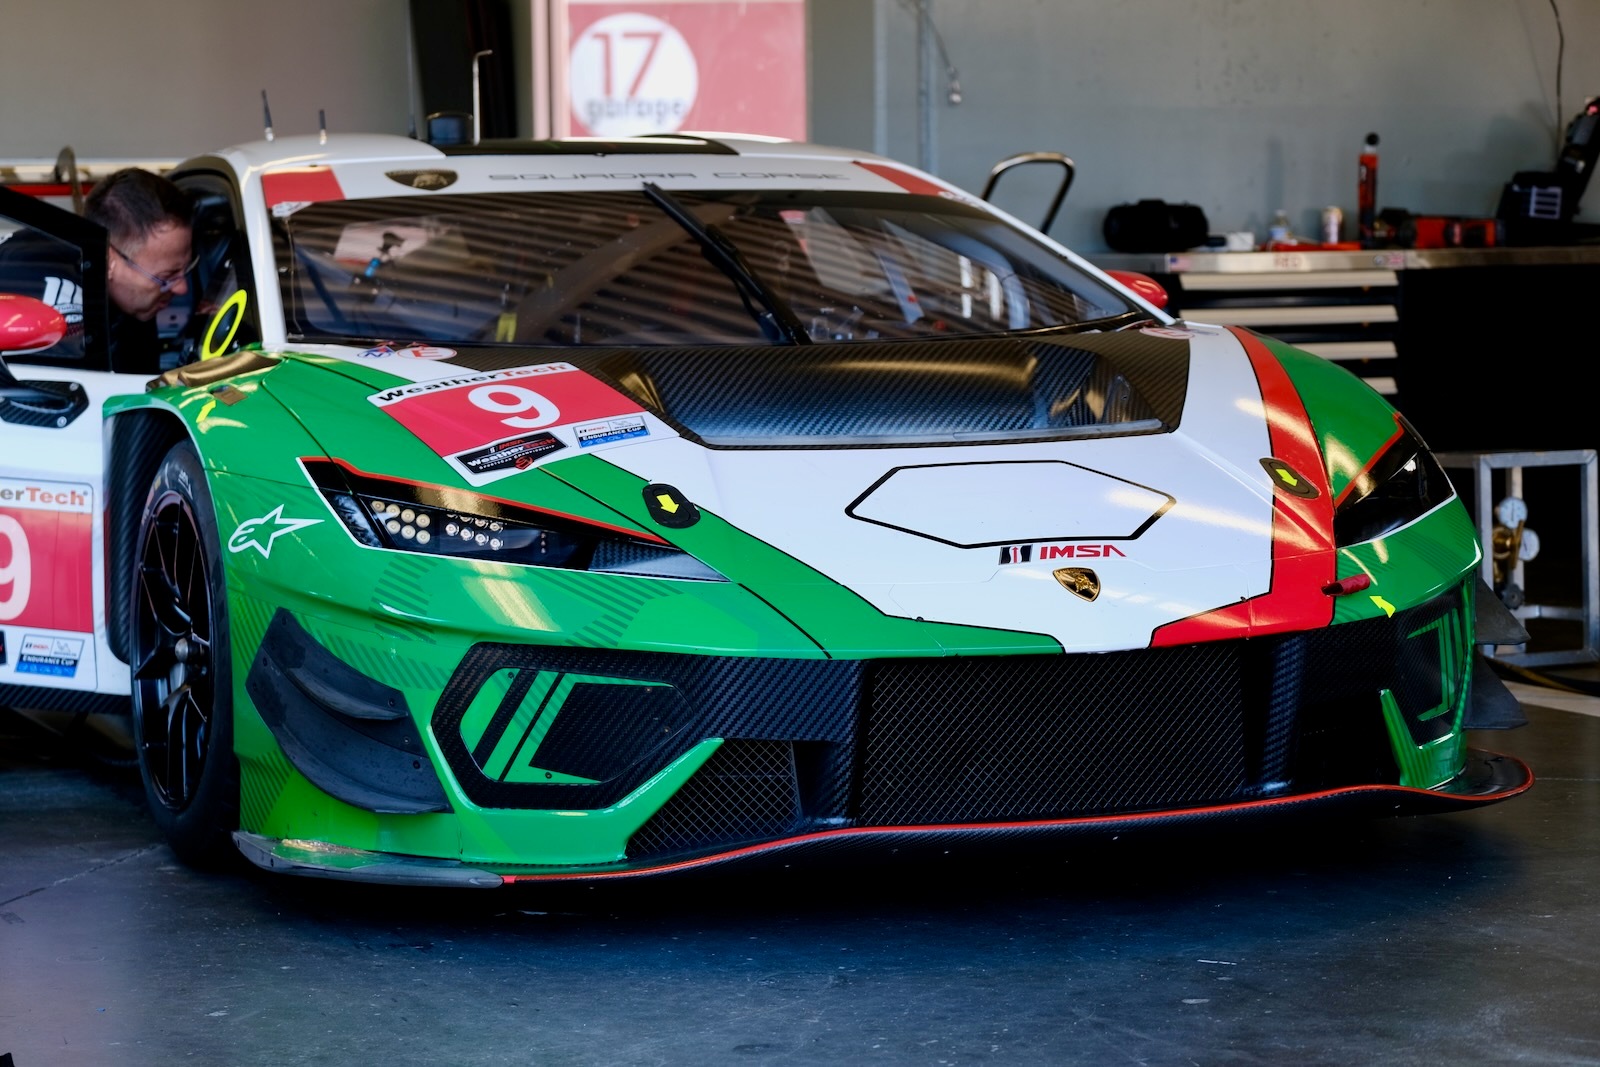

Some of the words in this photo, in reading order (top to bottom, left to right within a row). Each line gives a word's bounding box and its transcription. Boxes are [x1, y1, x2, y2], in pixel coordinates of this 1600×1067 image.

[592, 32, 663, 97] 17
[586, 100, 683, 126] garage
[489, 172, 697, 180] SQUADRA
[713, 172, 849, 180] CORSE
[468, 384, 561, 429] 9
[583, 429, 626, 441] ENDURANCE
[467, 438, 556, 467] WeatherTech
[1040, 544, 1127, 560] IMSA
[22, 654, 60, 665] ENDURANCE
[61, 659, 75, 667] CUP
